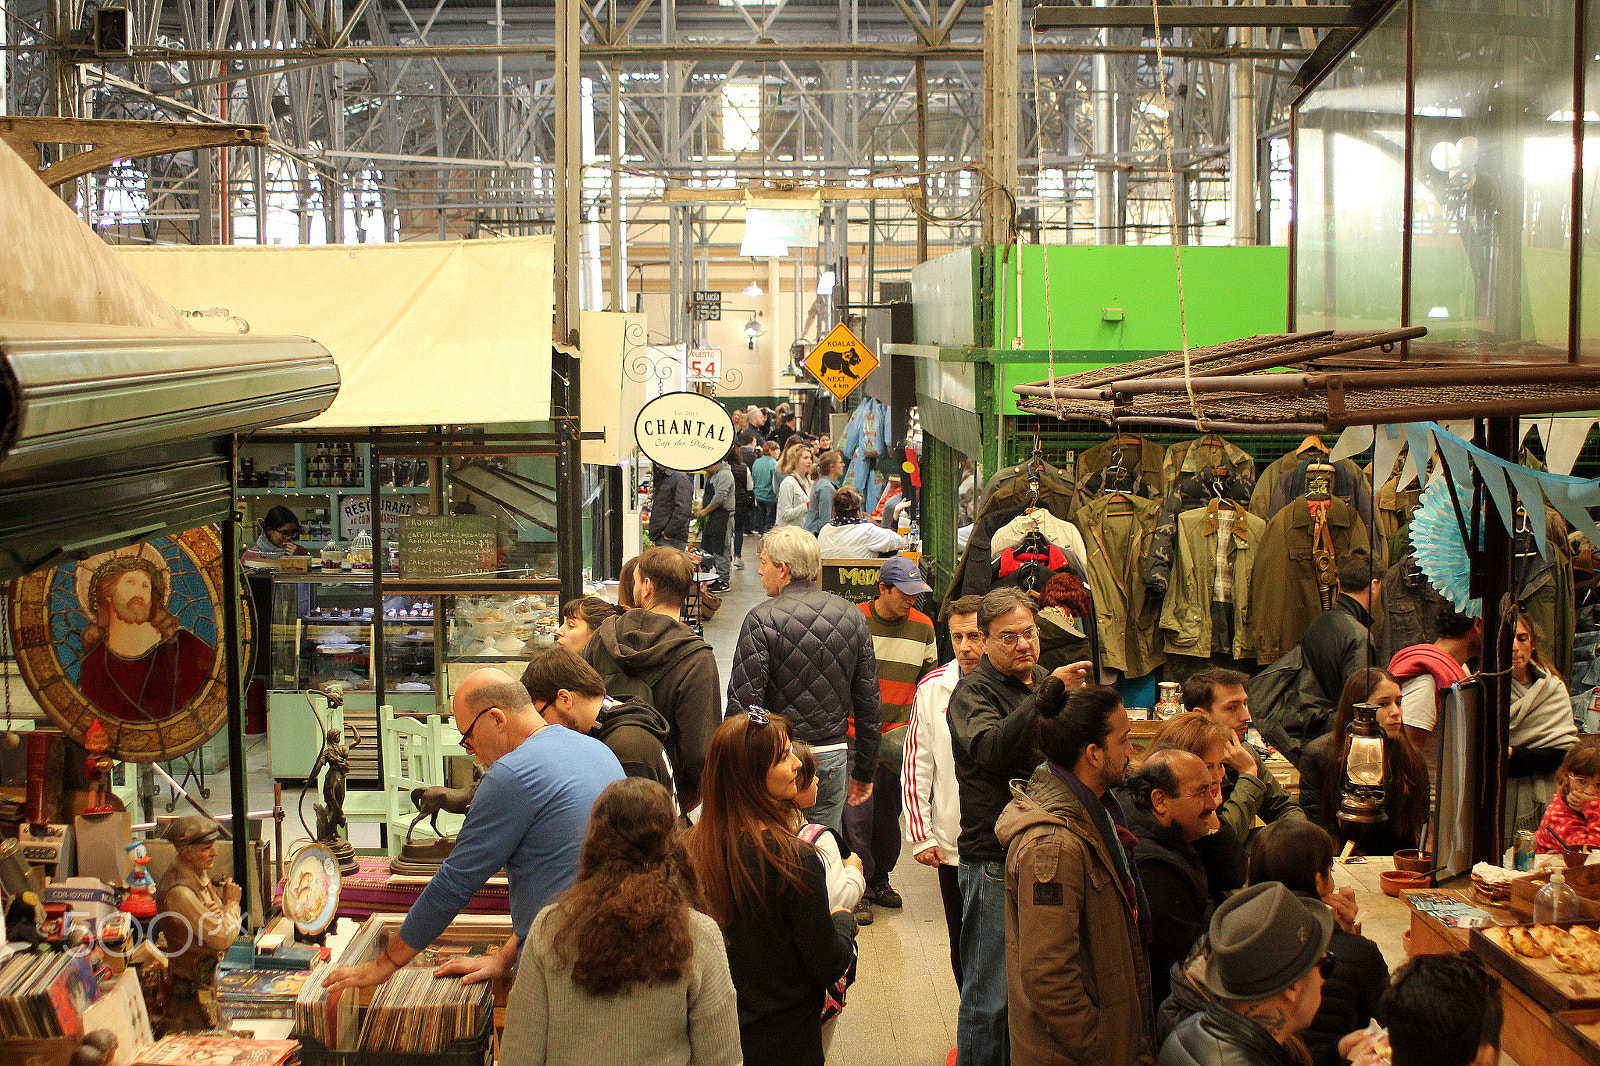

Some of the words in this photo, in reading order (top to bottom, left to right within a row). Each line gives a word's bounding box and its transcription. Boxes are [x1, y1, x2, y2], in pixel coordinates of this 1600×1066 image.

[691, 351, 715, 359] PUESTO
[691, 360, 716, 377] 54
[644, 419, 725, 442] CHANTAL
[344, 499, 412, 518] RESTURANT
[405, 518, 439, 527] PROMOS
